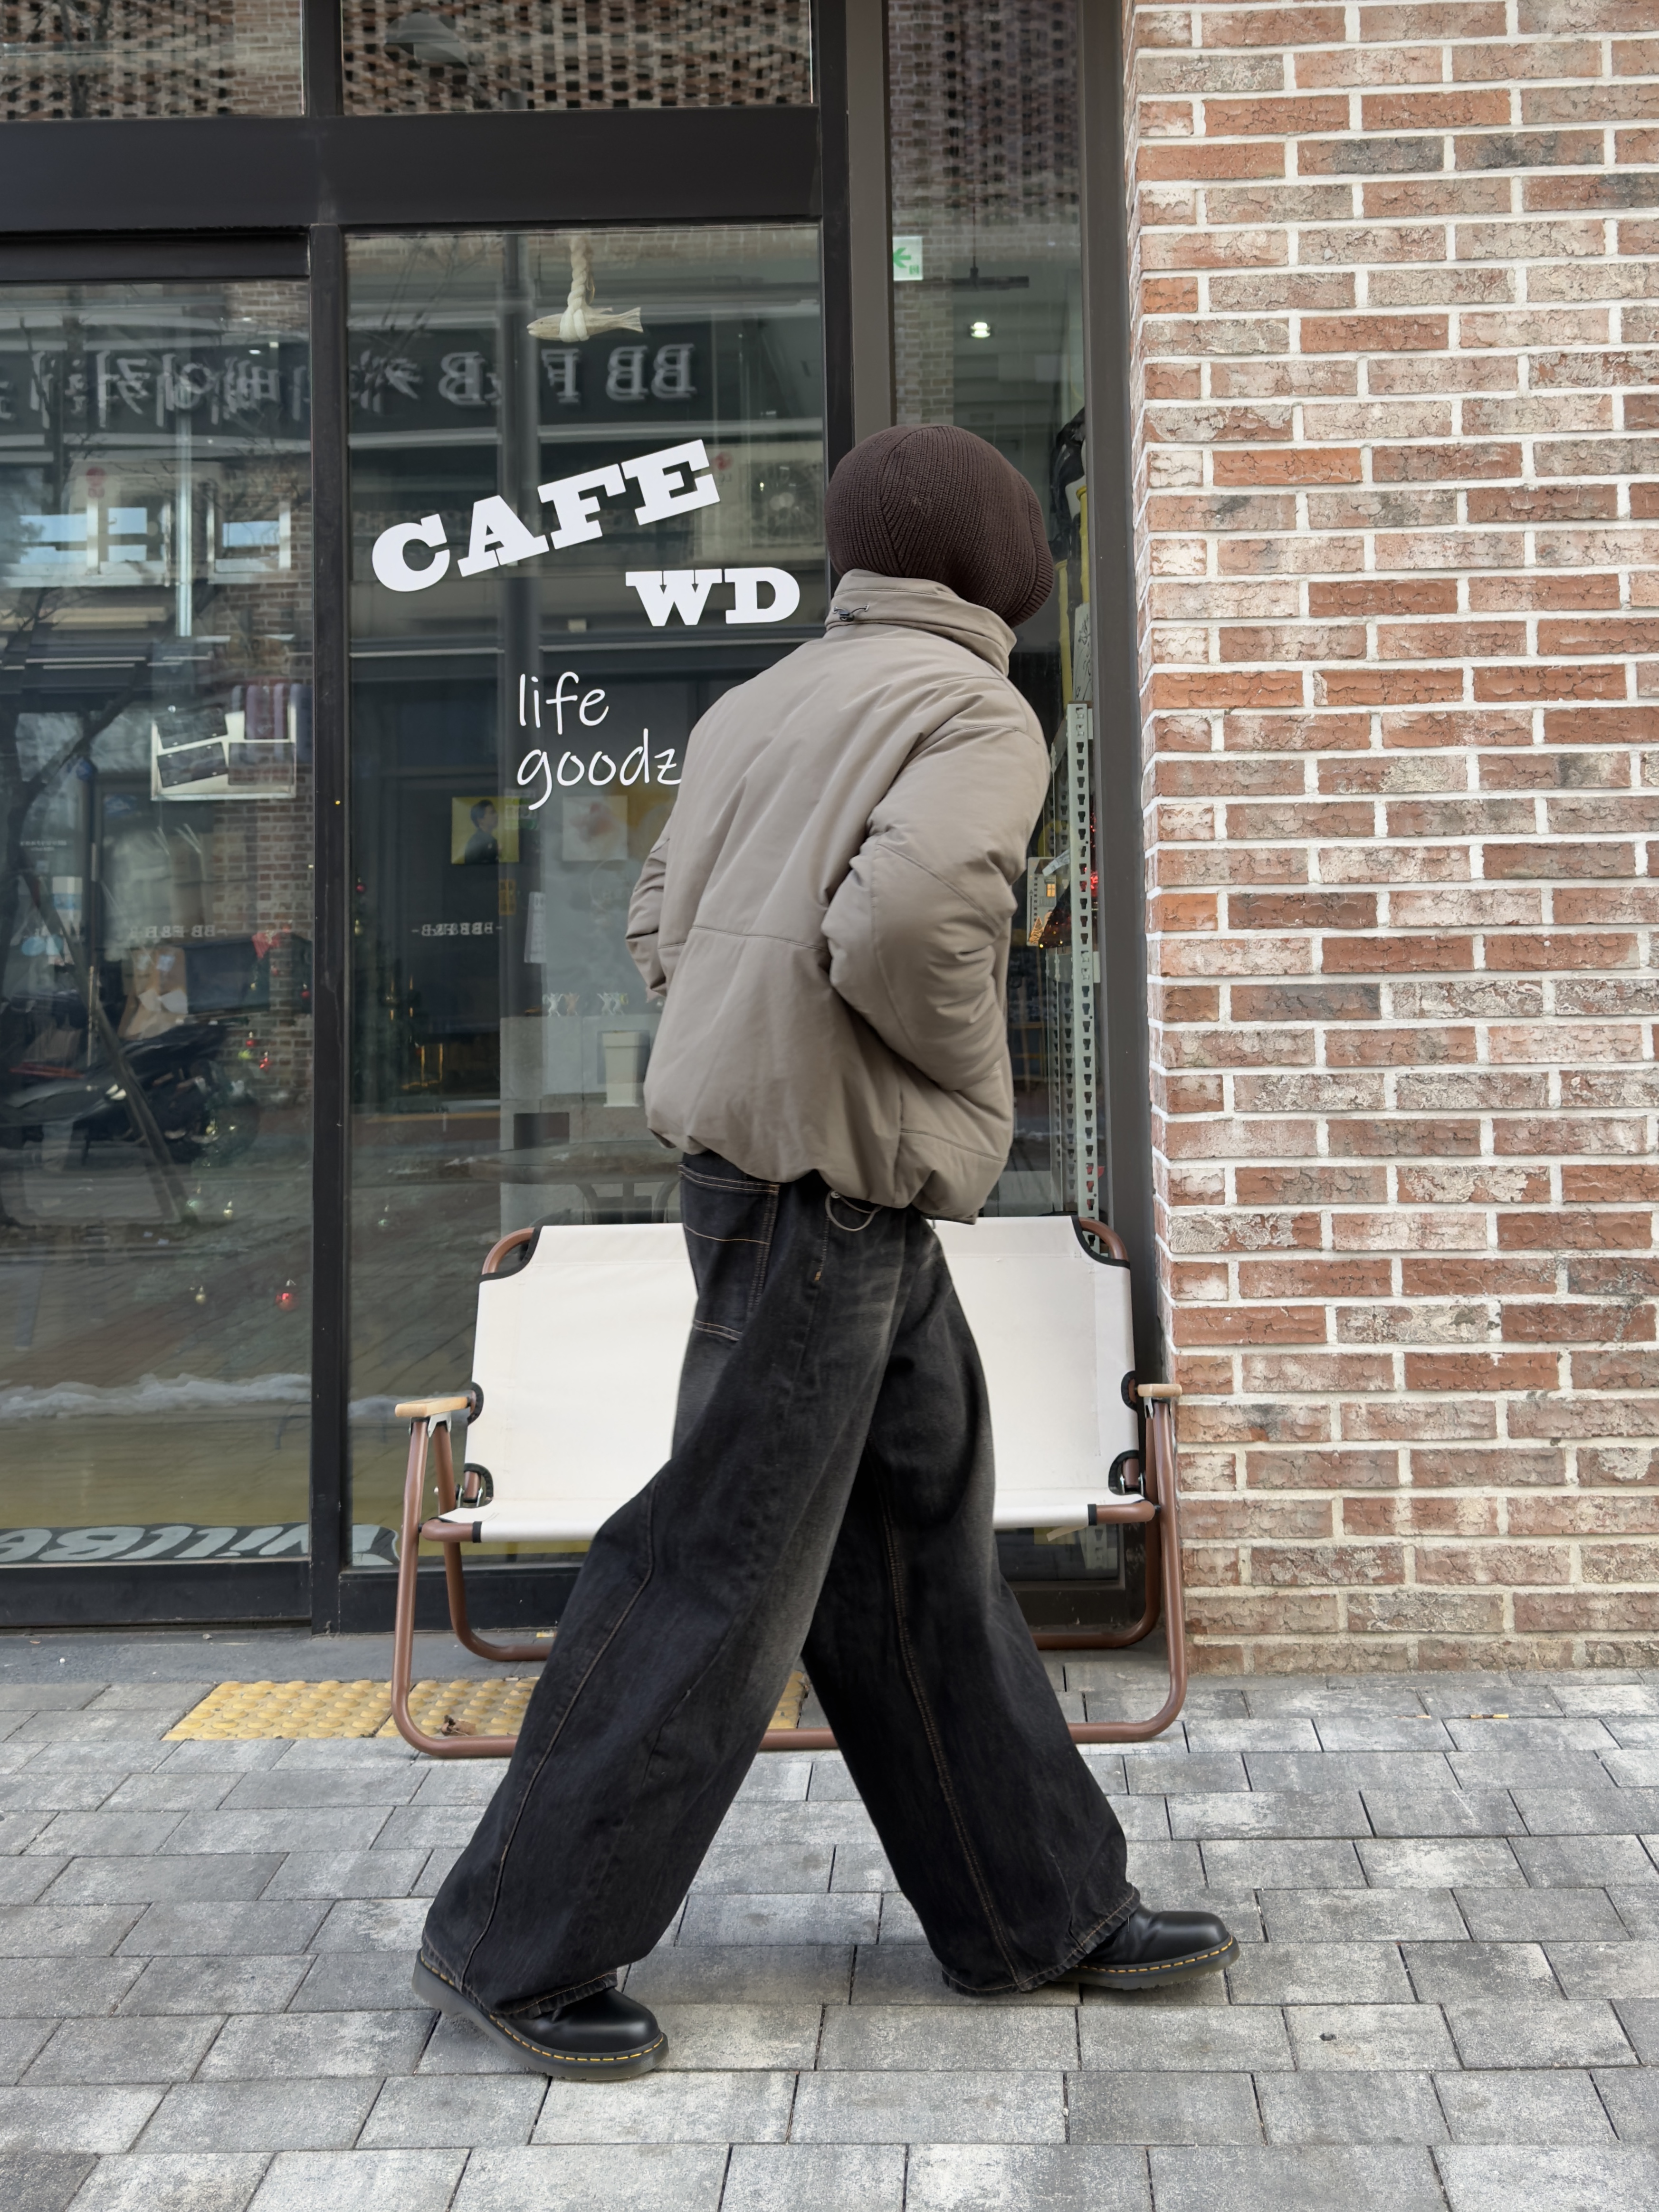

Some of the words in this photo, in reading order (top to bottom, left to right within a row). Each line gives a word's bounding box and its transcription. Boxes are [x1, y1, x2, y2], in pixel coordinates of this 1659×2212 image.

[372, 440, 719, 591] CAFE
[626, 567, 800, 626] WD
[519, 671, 609, 735] life
[517, 728, 681, 810] goodz
